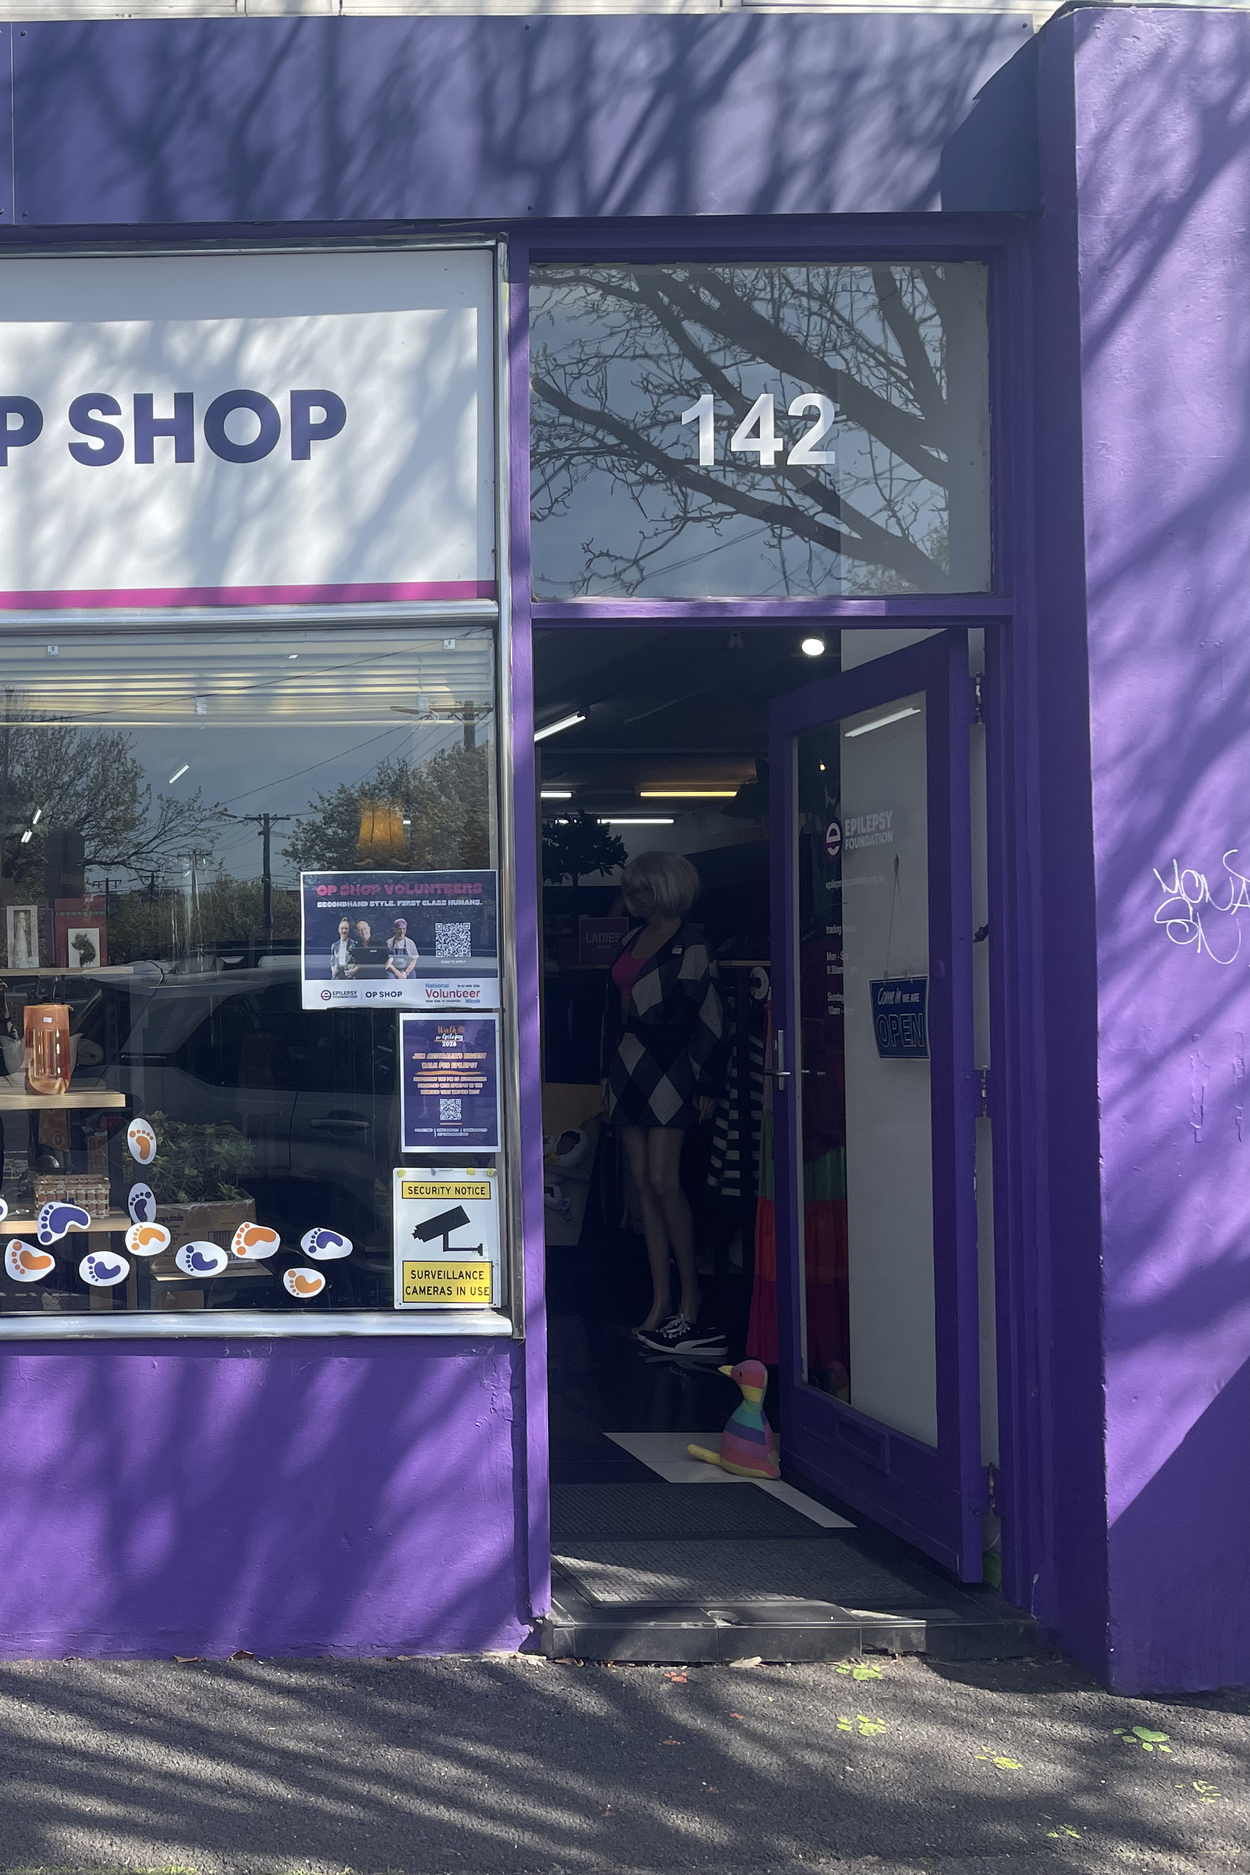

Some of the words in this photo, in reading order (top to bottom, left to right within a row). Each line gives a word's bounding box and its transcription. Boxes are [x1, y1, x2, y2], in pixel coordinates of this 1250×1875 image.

[68, 389, 347, 467] SHOP
[682, 393, 836, 466] 142
[845, 811, 893, 837] EPILEPSY
[845, 830, 893, 850] FOUNDATION
[317, 884, 337, 896] OP
[340, 884, 382, 896] SHOP
[384, 883, 483, 895] VOLUNTEERS
[586, 933, 621, 943] LADIES
[425, 989, 480, 998] Volunteer
[877, 1013, 924, 1048] OPEN
[407, 1186, 451, 1195] SECURITY
[455, 1186, 486, 1195] NOTICE
[410, 1270, 484, 1280] SURVEILLANCE
[405, 1286, 453, 1296] CAMERAS
[456, 1287, 466, 1296] IN
[470, 1287, 490, 1296] USE
